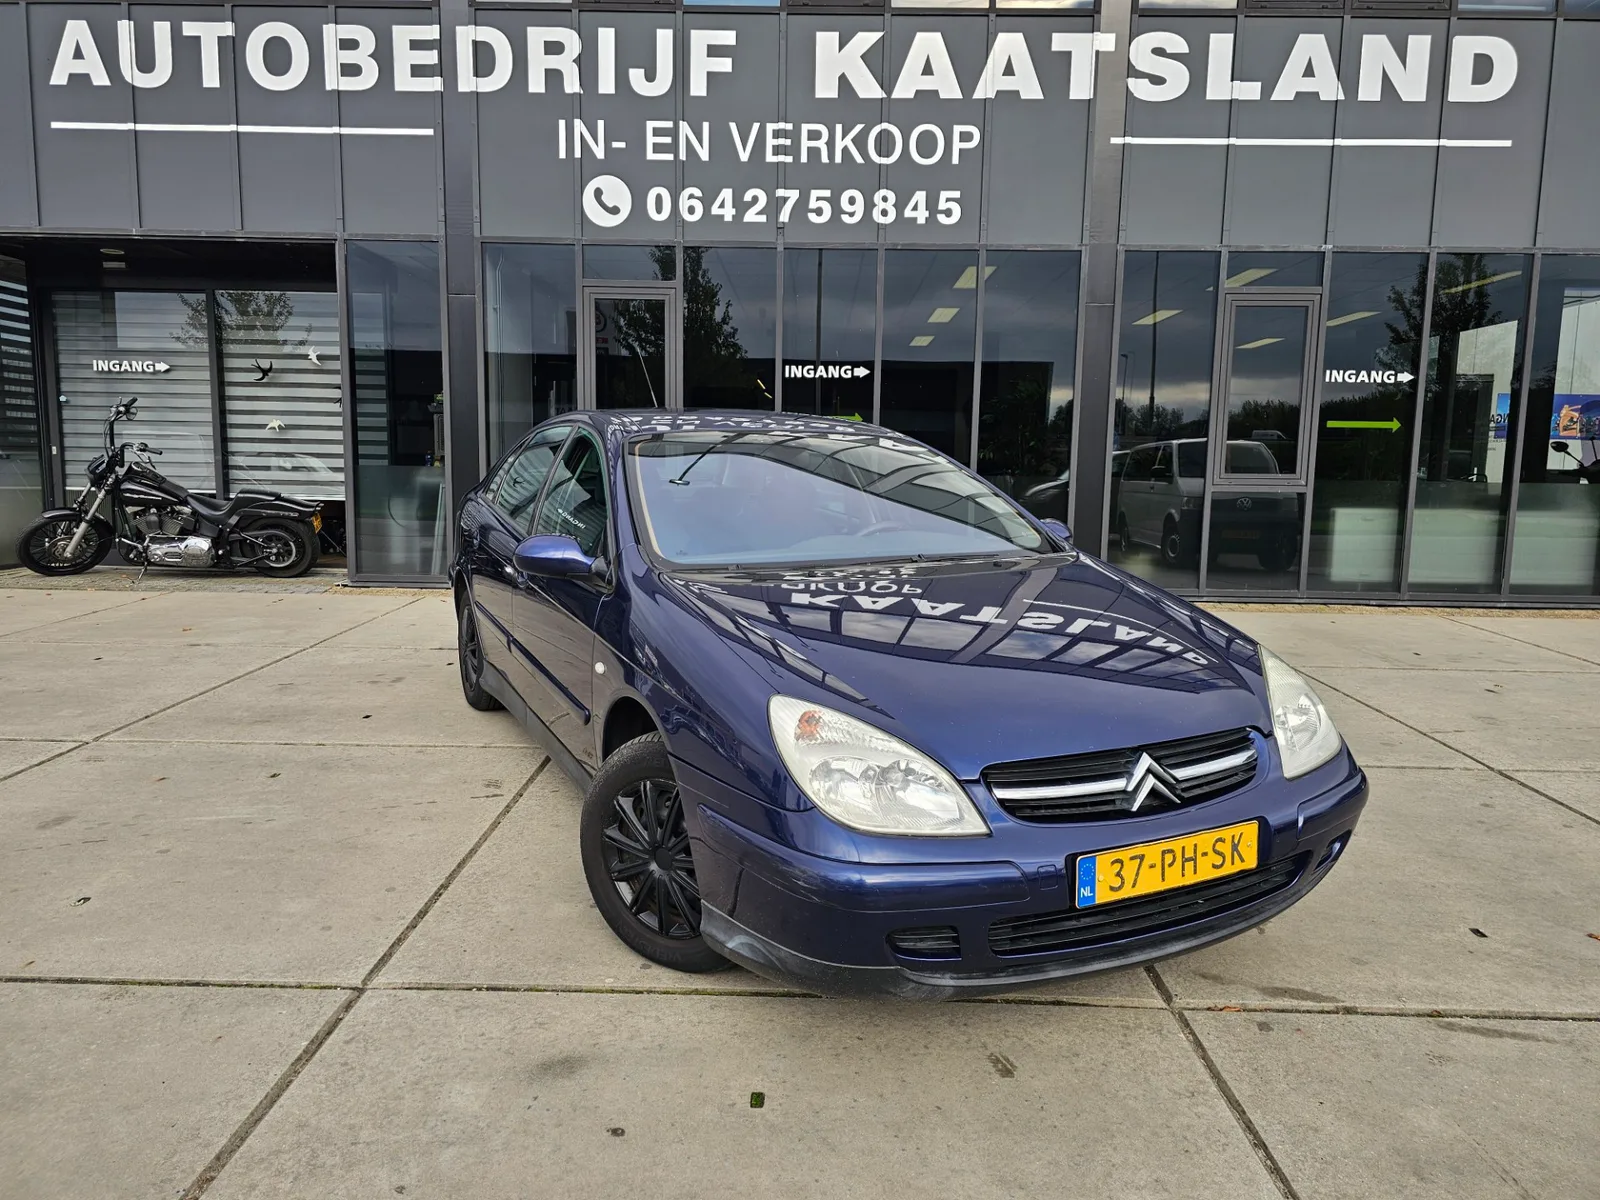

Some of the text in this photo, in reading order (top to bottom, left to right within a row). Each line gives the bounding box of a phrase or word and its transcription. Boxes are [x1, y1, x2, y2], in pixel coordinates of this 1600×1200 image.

[49, 19, 1518, 103] AUTOBEDRIJF KAATSLAND
[558, 118, 981, 167] IN- EN VERKOOP
[646, 186, 963, 226] 0642759845
[92, 359, 154, 373] INGANG
[784, 365, 852, 379] INGANG
[1325, 369, 1395, 384] INGANG
[1109, 832, 1245, 892] 37-PH-SK
[1080, 886, 1094, 897] NL
